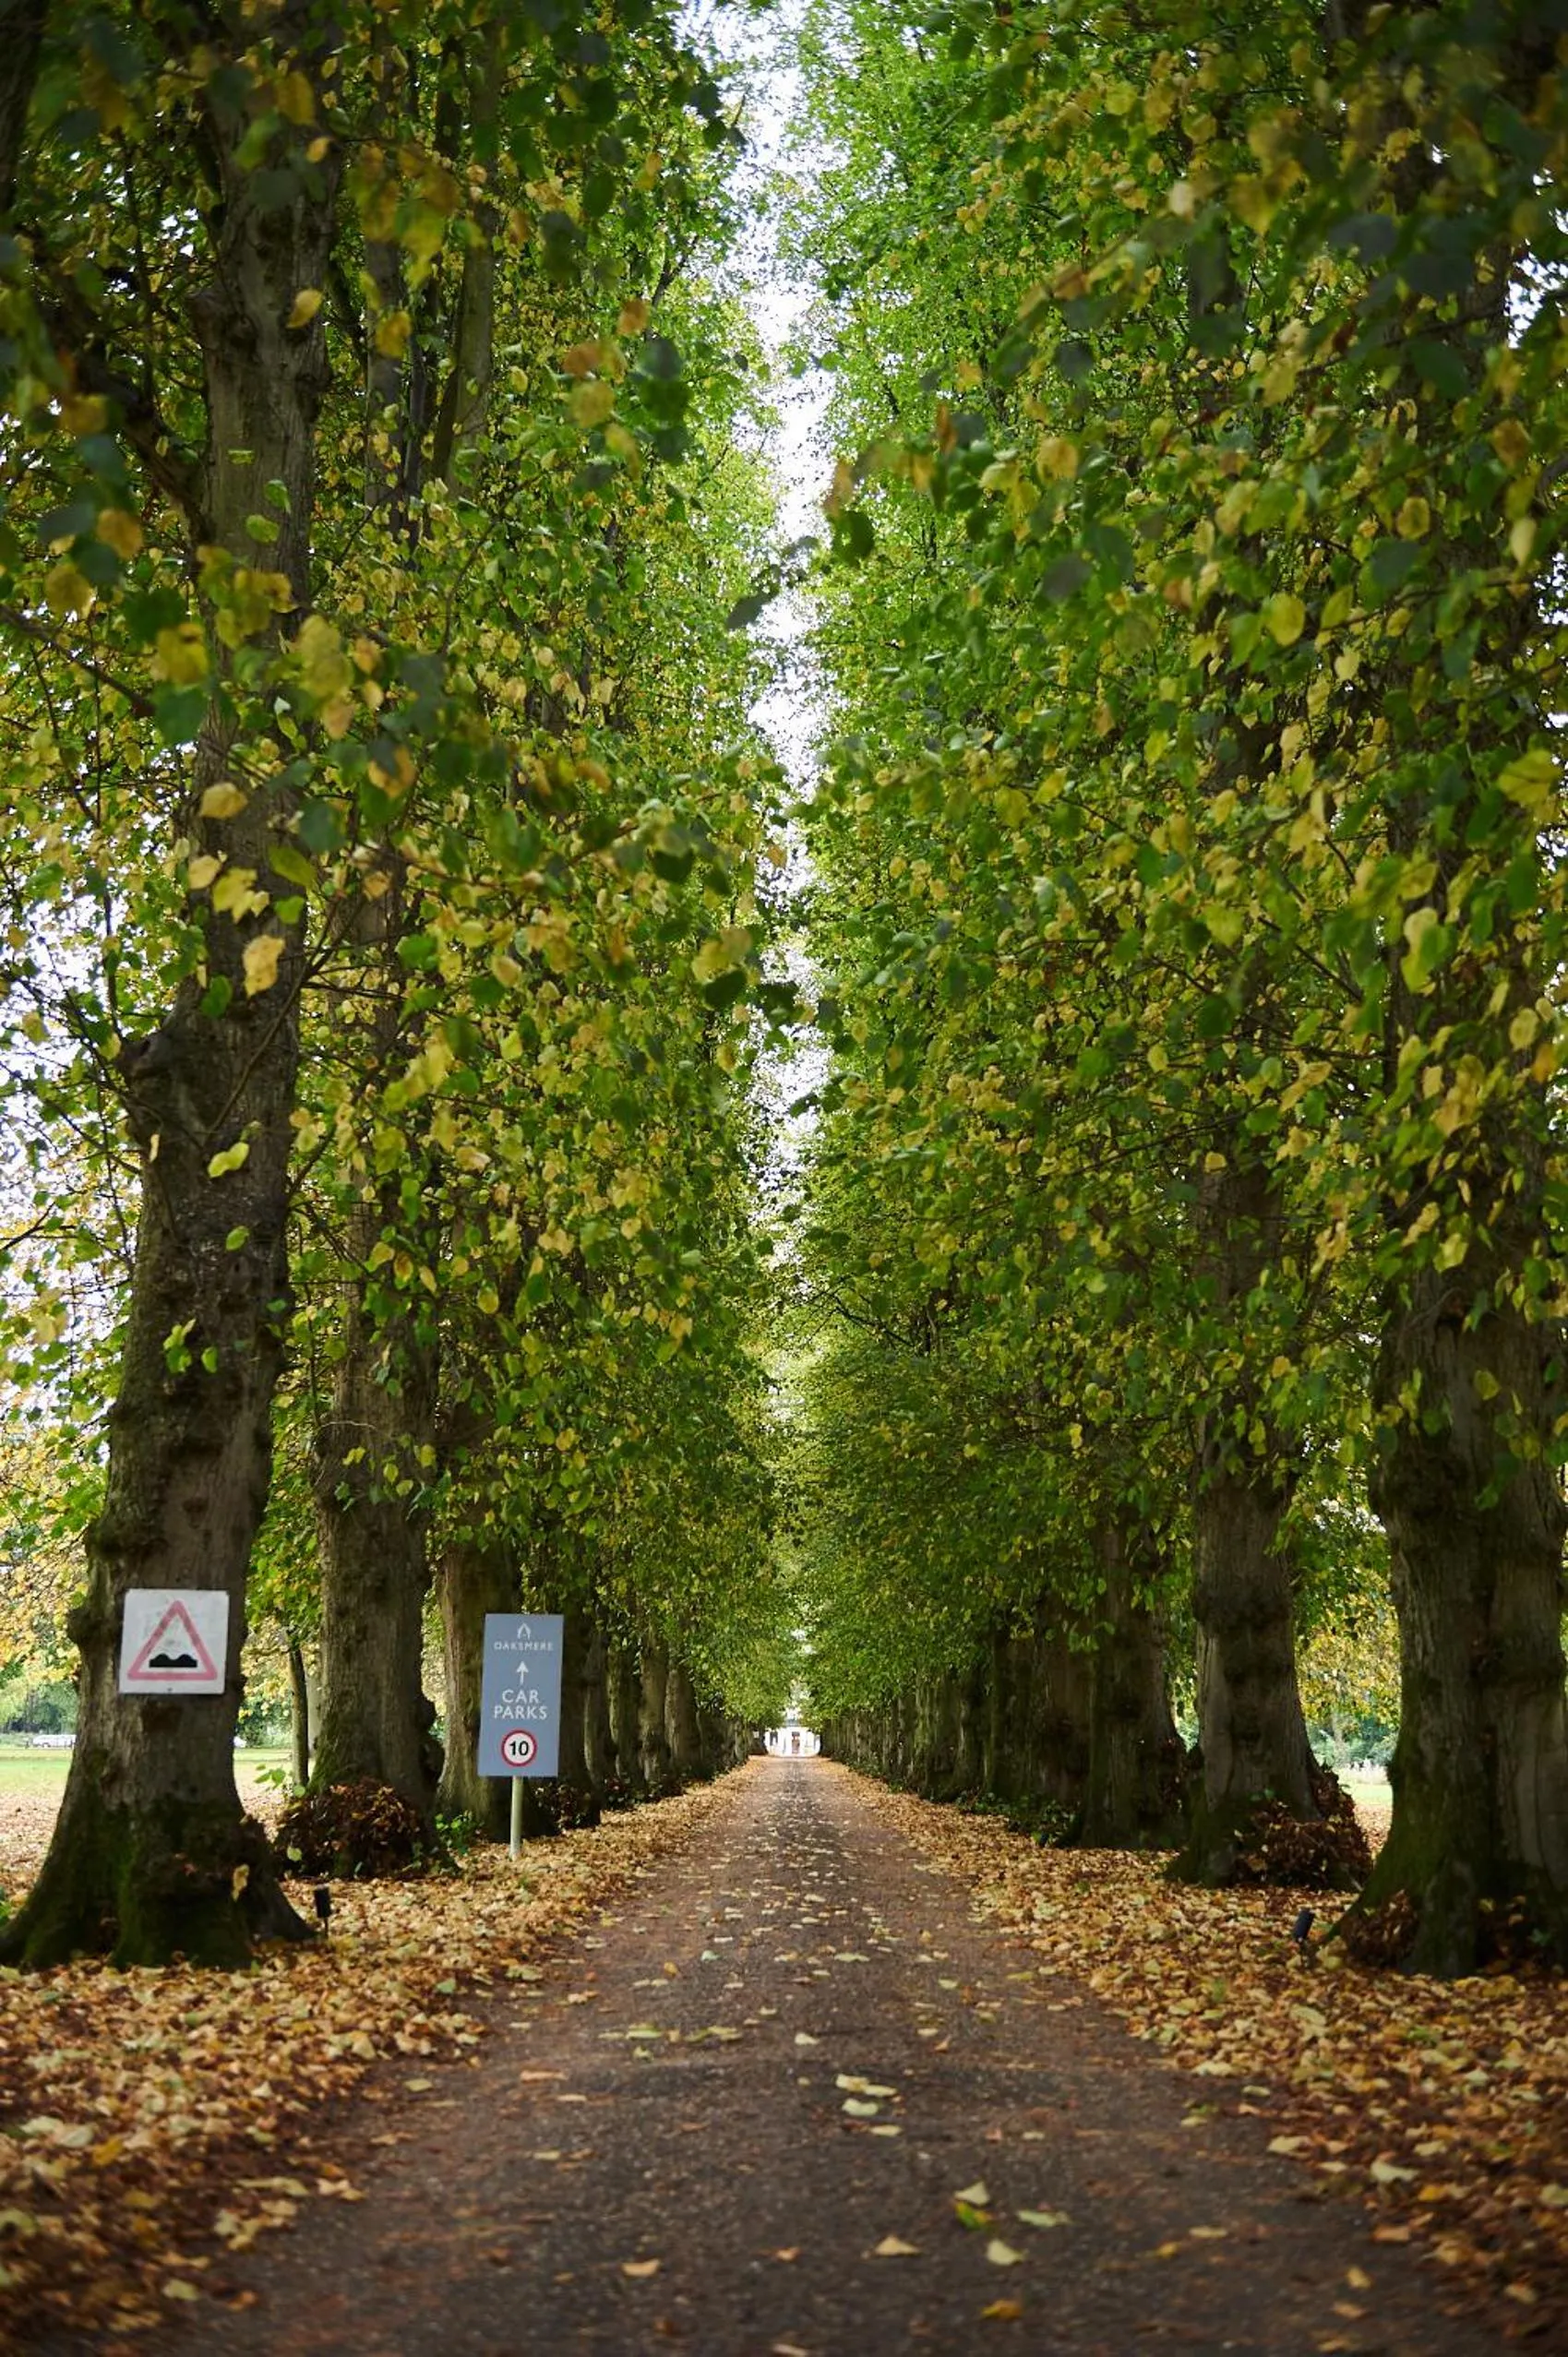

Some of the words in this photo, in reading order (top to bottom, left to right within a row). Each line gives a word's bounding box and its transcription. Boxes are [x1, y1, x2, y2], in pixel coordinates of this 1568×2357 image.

[494, 1641, 554, 1651] OAKSMERE
[501, 1690, 539, 1704] CAR
[494, 1706, 548, 1719] PARKS
[509, 1741, 529, 1756] 10
